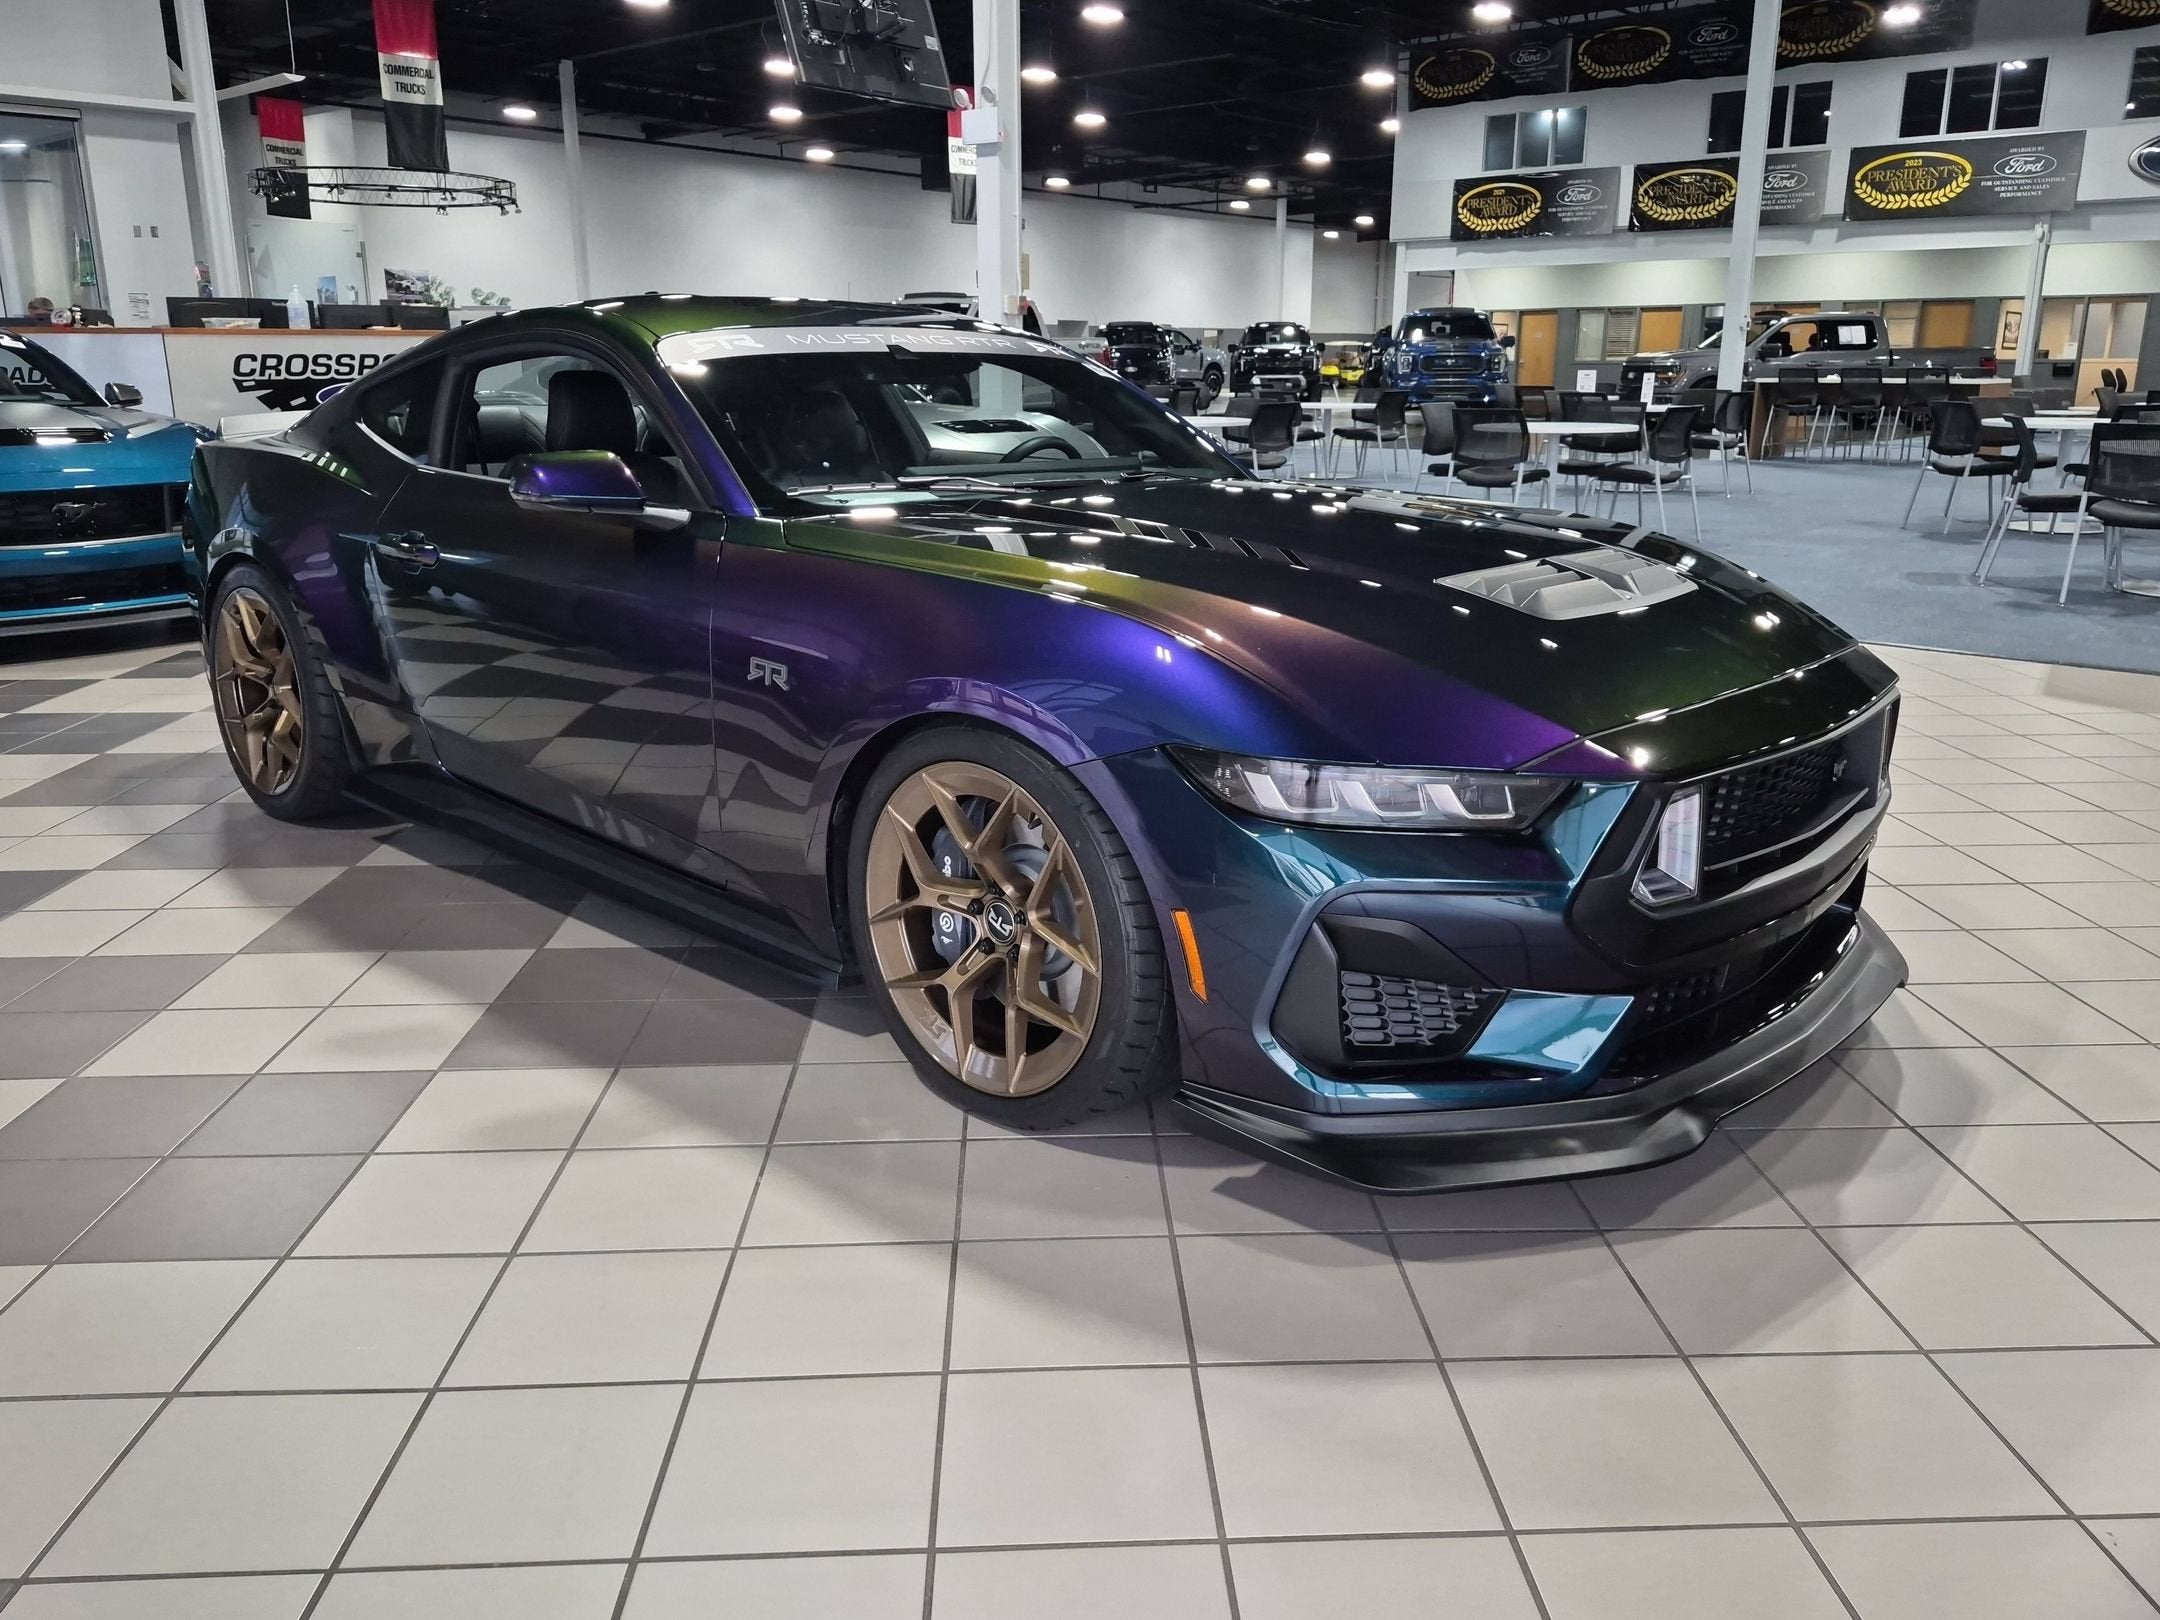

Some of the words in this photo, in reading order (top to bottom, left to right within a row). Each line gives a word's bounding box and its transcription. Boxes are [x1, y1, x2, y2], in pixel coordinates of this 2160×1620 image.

[1697, 27, 1728, 42] Ford
[394, 81, 426, 95] TRUCKS
[2004, 156, 2046, 174] Ford
[1764, 173, 1798, 188] Ford
[1867, 165, 1962, 182] PRESIDENT'S
[1885, 179, 1937, 192] AWARD
[1466, 194, 1535, 210] PRESIDENT'S
[1564, 187, 1593, 202] Ford
[1480, 204, 1518, 217] AWARD
[785, 332, 952, 346] MUSTANG
[952, 335, 1018, 349] RTR
[232, 353, 398, 377] CROSSP
[746, 656, 791, 691] RTR
